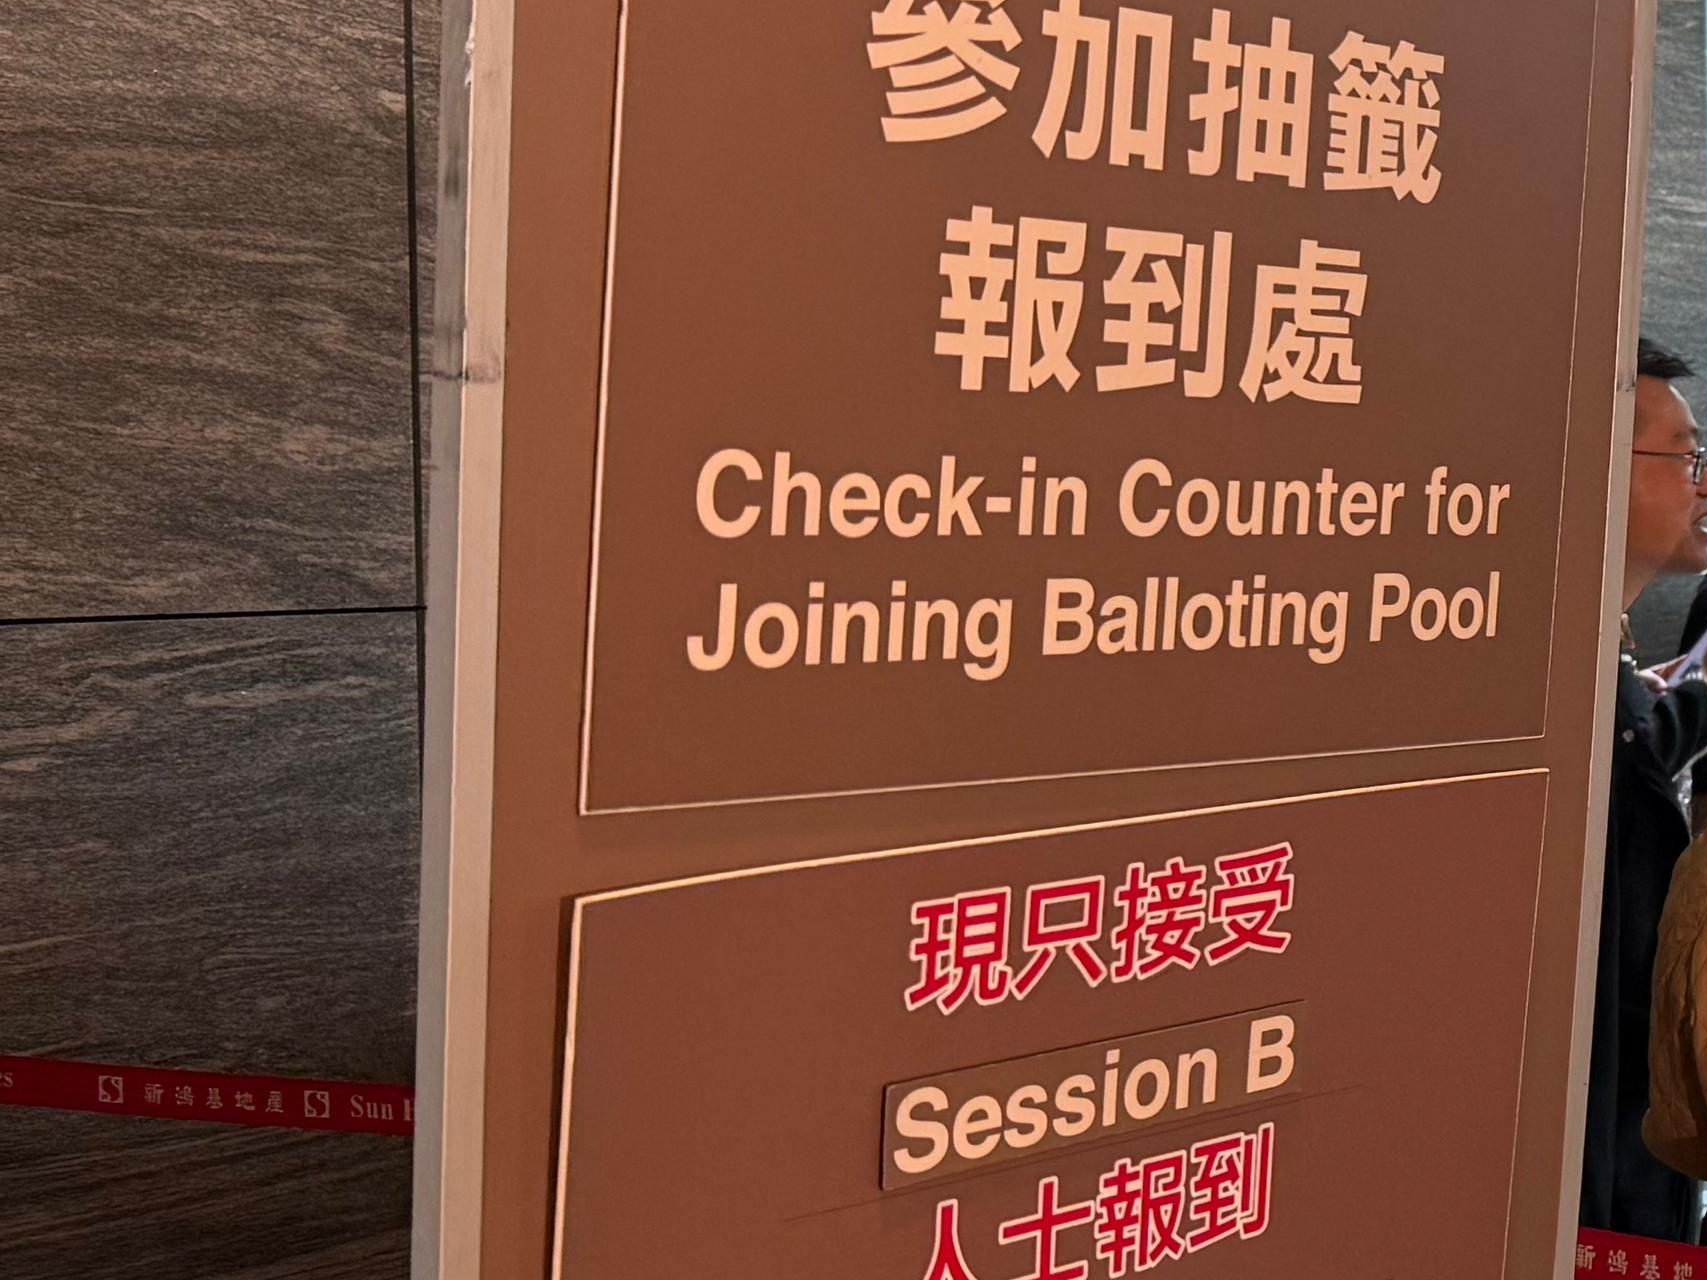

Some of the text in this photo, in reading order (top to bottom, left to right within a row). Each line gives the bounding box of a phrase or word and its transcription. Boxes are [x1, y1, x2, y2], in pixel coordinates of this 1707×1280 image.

[934, 206, 1368, 403] 報到處
[696, 448, 1510, 537] Check-in Counter for
[687, 571, 1500, 680] Joining Balloting Pool
[904, 842, 1295, 1015] 現只接受
[350, 1095, 393, 1121] Sun
[890, 1015, 1295, 1175] Session B
